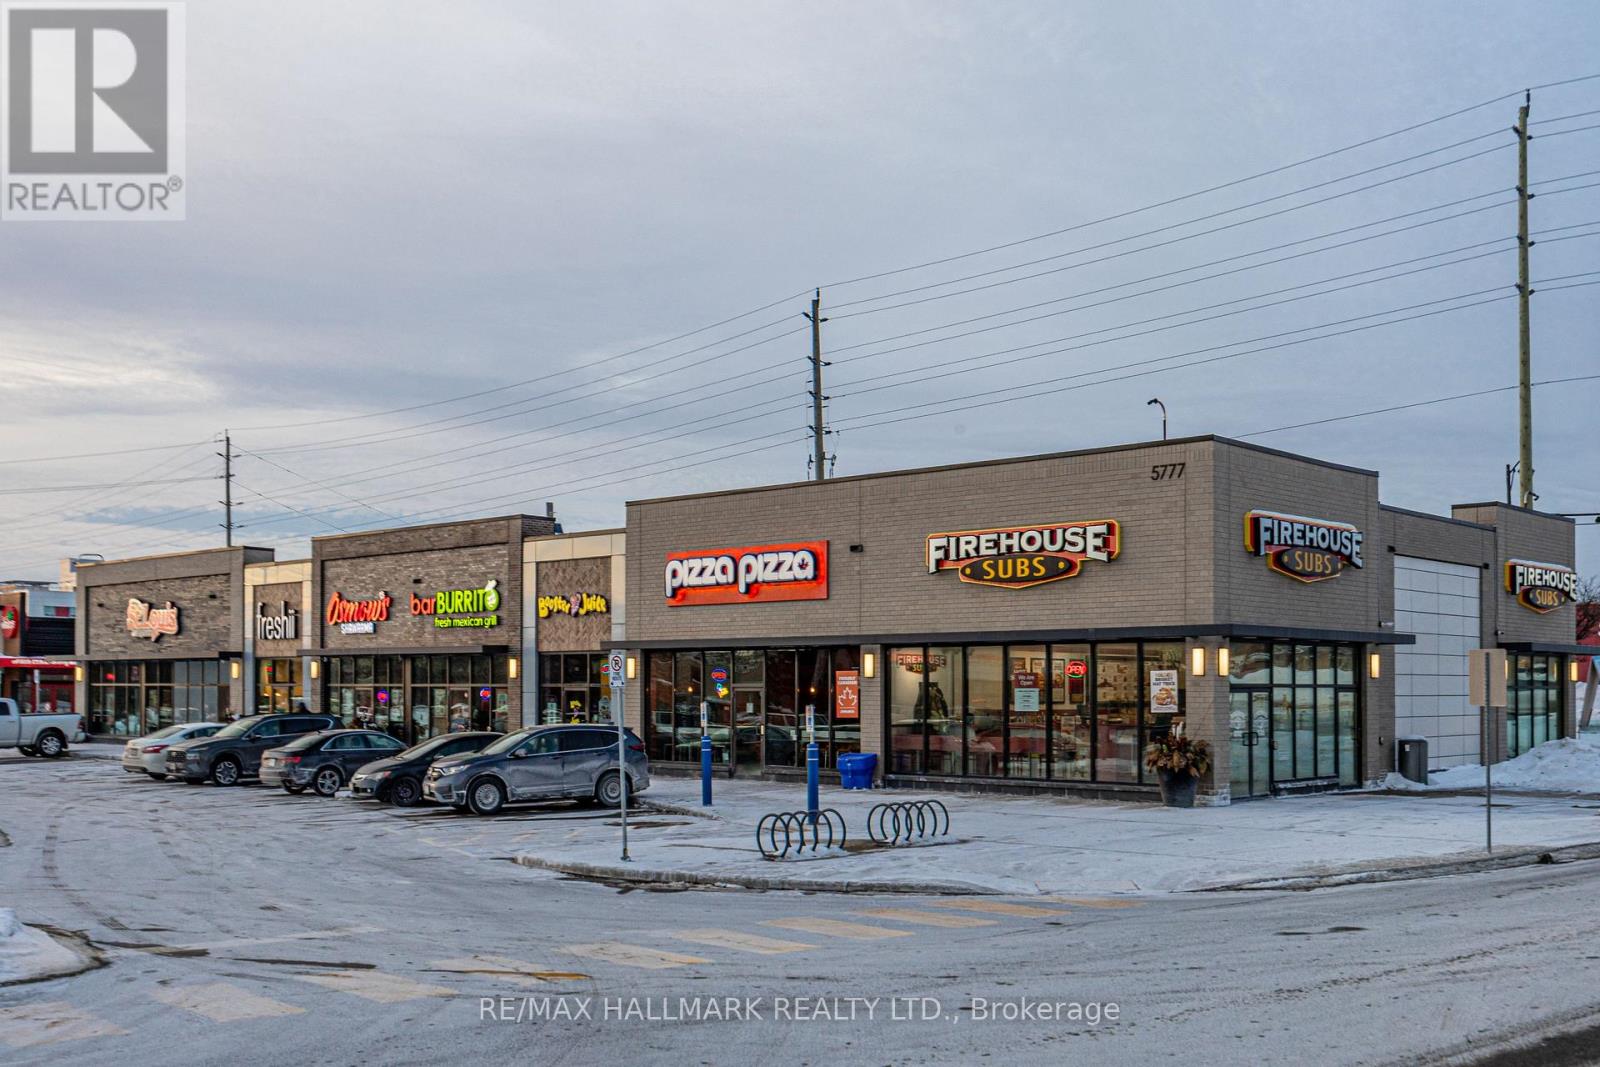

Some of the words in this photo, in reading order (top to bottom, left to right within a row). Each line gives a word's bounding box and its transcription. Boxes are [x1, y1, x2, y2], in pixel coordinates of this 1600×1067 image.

[1151, 463, 1186, 481] 5777
[927, 523, 1111, 575] FIREHOUSE
[1255, 516, 1363, 569] FIREHOUSE
[982, 555, 1047, 580] SUBS
[1294, 550, 1332, 574] SUBS
[1515, 565, 1577, 603] FIREHOUSE
[1535, 589, 1559, 607] SUBS
[256, 600, 296, 640] freshii
[434, 617, 452, 628] fresh
[453, 615, 483, 627] mexican
[484, 615, 498, 629] grill
[896, 654, 946, 668] FIREHUSE
[1065, 663, 1087, 676] OPEN
